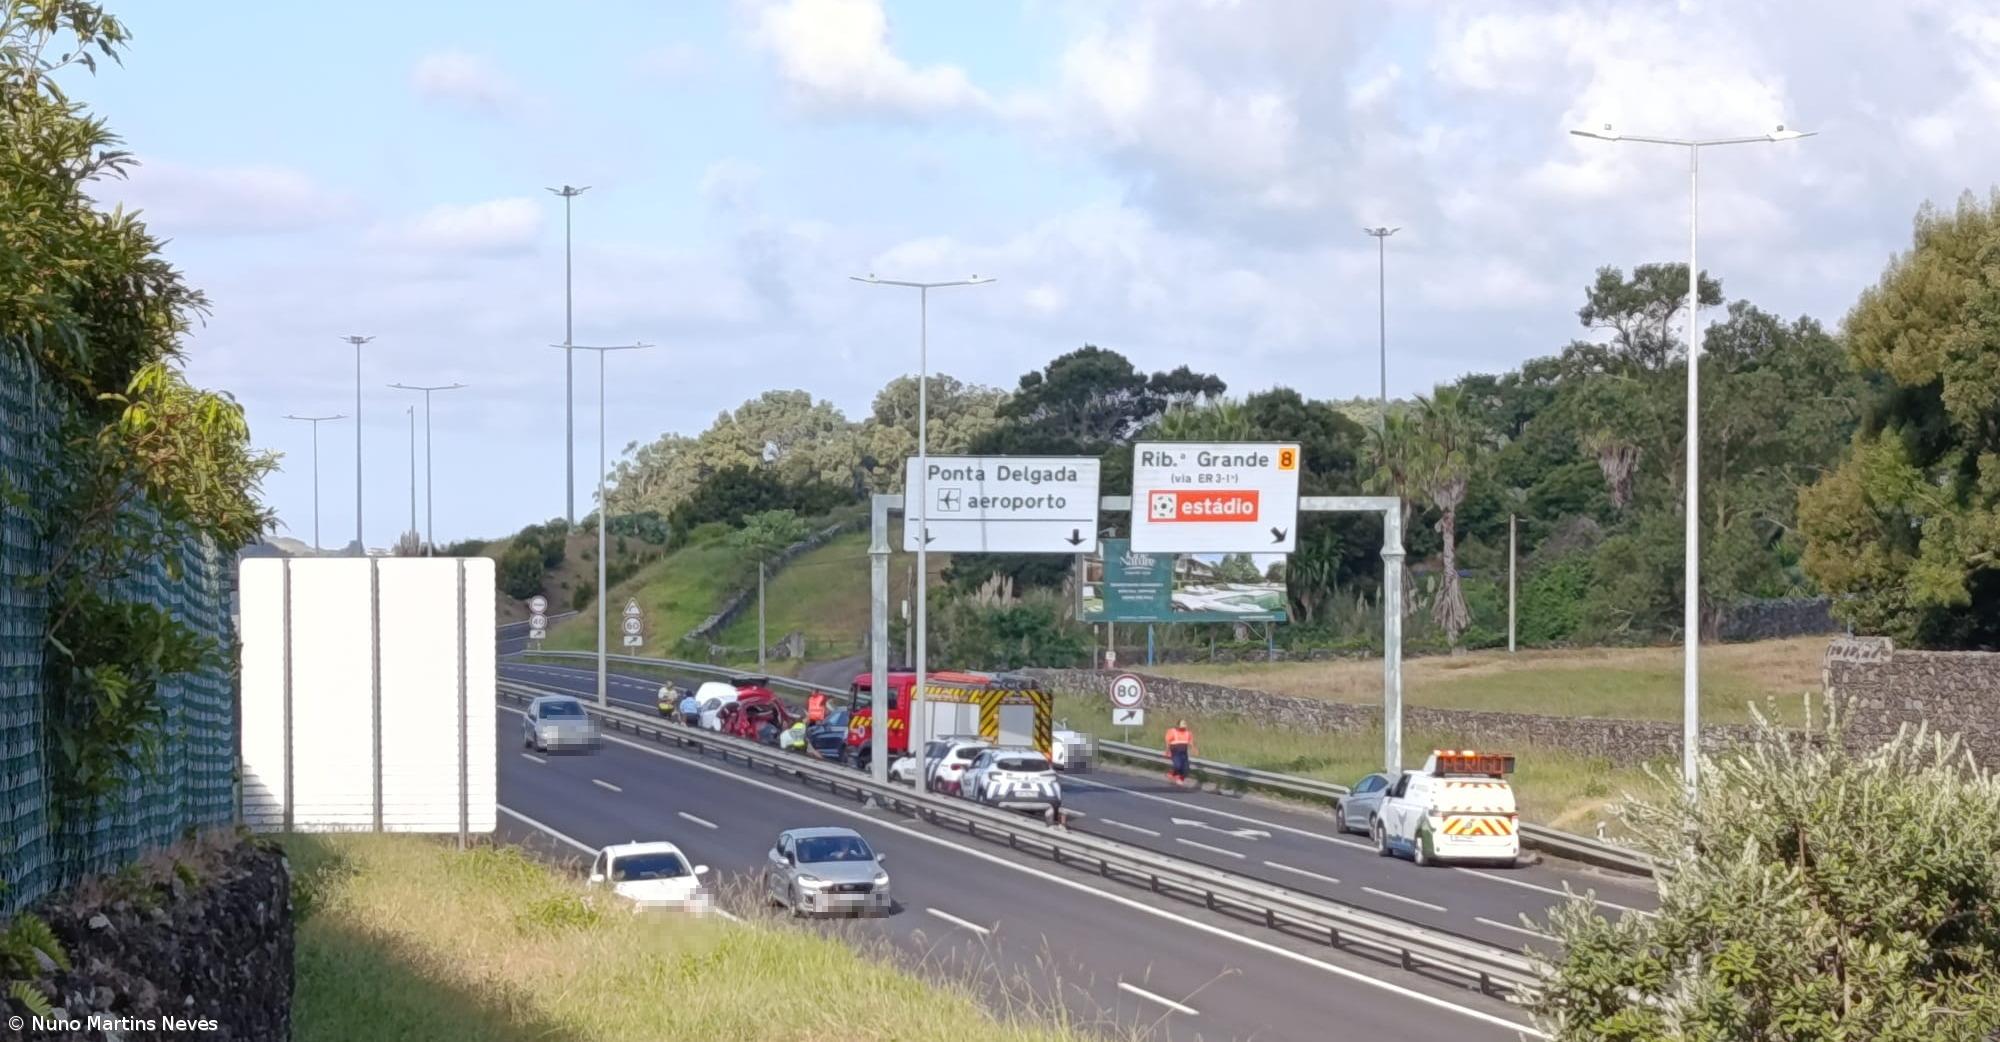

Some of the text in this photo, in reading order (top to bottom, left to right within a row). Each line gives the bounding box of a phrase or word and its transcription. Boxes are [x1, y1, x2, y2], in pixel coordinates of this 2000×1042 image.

[1197, 451, 1269, 467] Grande
[1281, 452, 1293, 467] 8
[928, 465, 1078, 485] Ponta Delgada
[1171, 473, 1192, 484] (via
[968, 494, 1066, 511] aeroporto
[1181, 495, 1254, 515] estádio
[1118, 685, 1138, 698] 80
